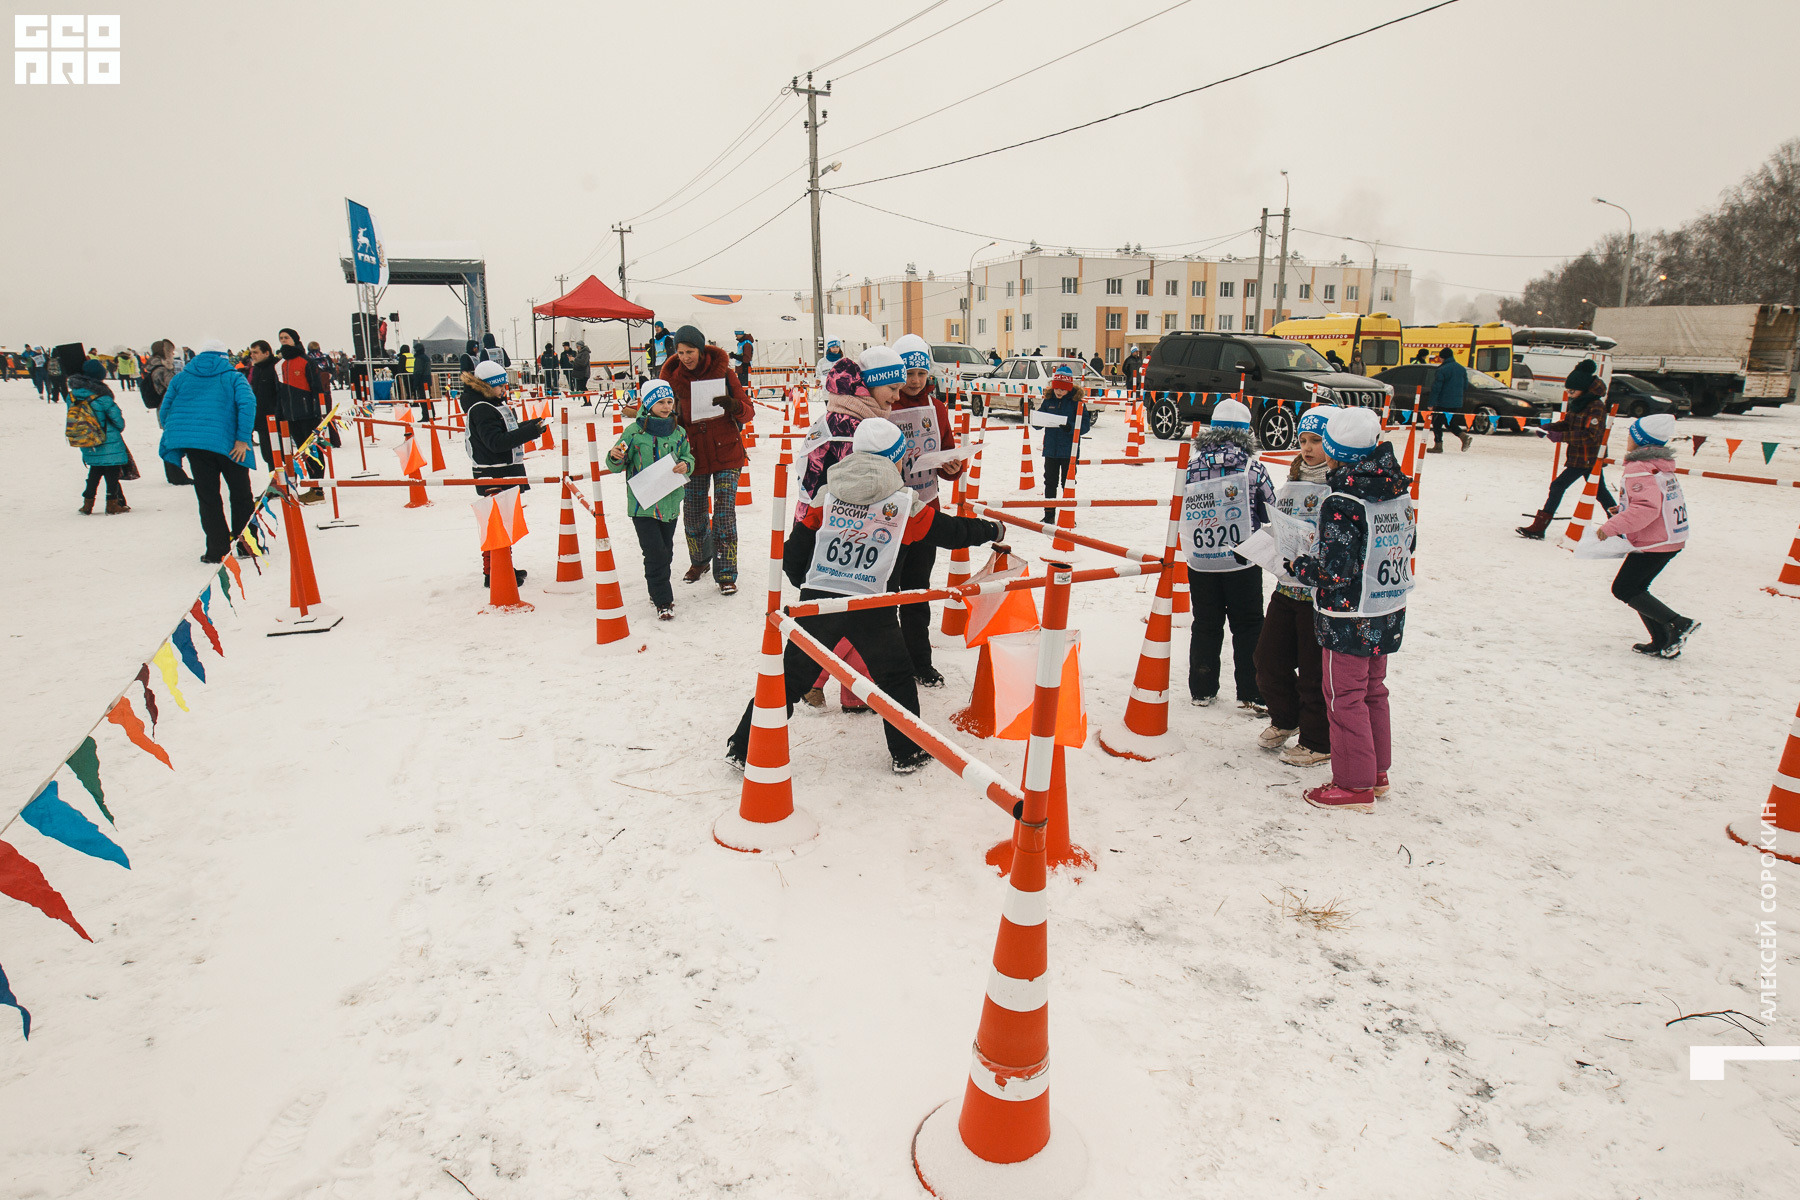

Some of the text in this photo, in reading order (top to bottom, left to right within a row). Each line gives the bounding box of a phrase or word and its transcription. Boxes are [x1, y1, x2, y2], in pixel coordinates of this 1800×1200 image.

[357, 252, 376, 264] ГАЗ
[867, 369, 900, 383] ЛЫЖНЯ
[1185, 492, 1215, 503] ЛЫЖНЯ
[1185, 500, 1216, 511] РОССИИ
[831, 505, 868, 519] РОССИИ
[1186, 509, 1216, 520] 2020
[829, 515, 864, 530] 2020
[1197, 517, 1220, 528] 172
[1373, 513, 1399, 524] ЛЫЖНЯ
[1375, 523, 1400, 534] РОССИИ
[838, 528, 869, 545] 172
[1193, 523, 1240, 548] 6320
[826, 536, 879, 570] 6319
[1387, 546, 1403, 560] 172
[854, 572, 877, 583] область
